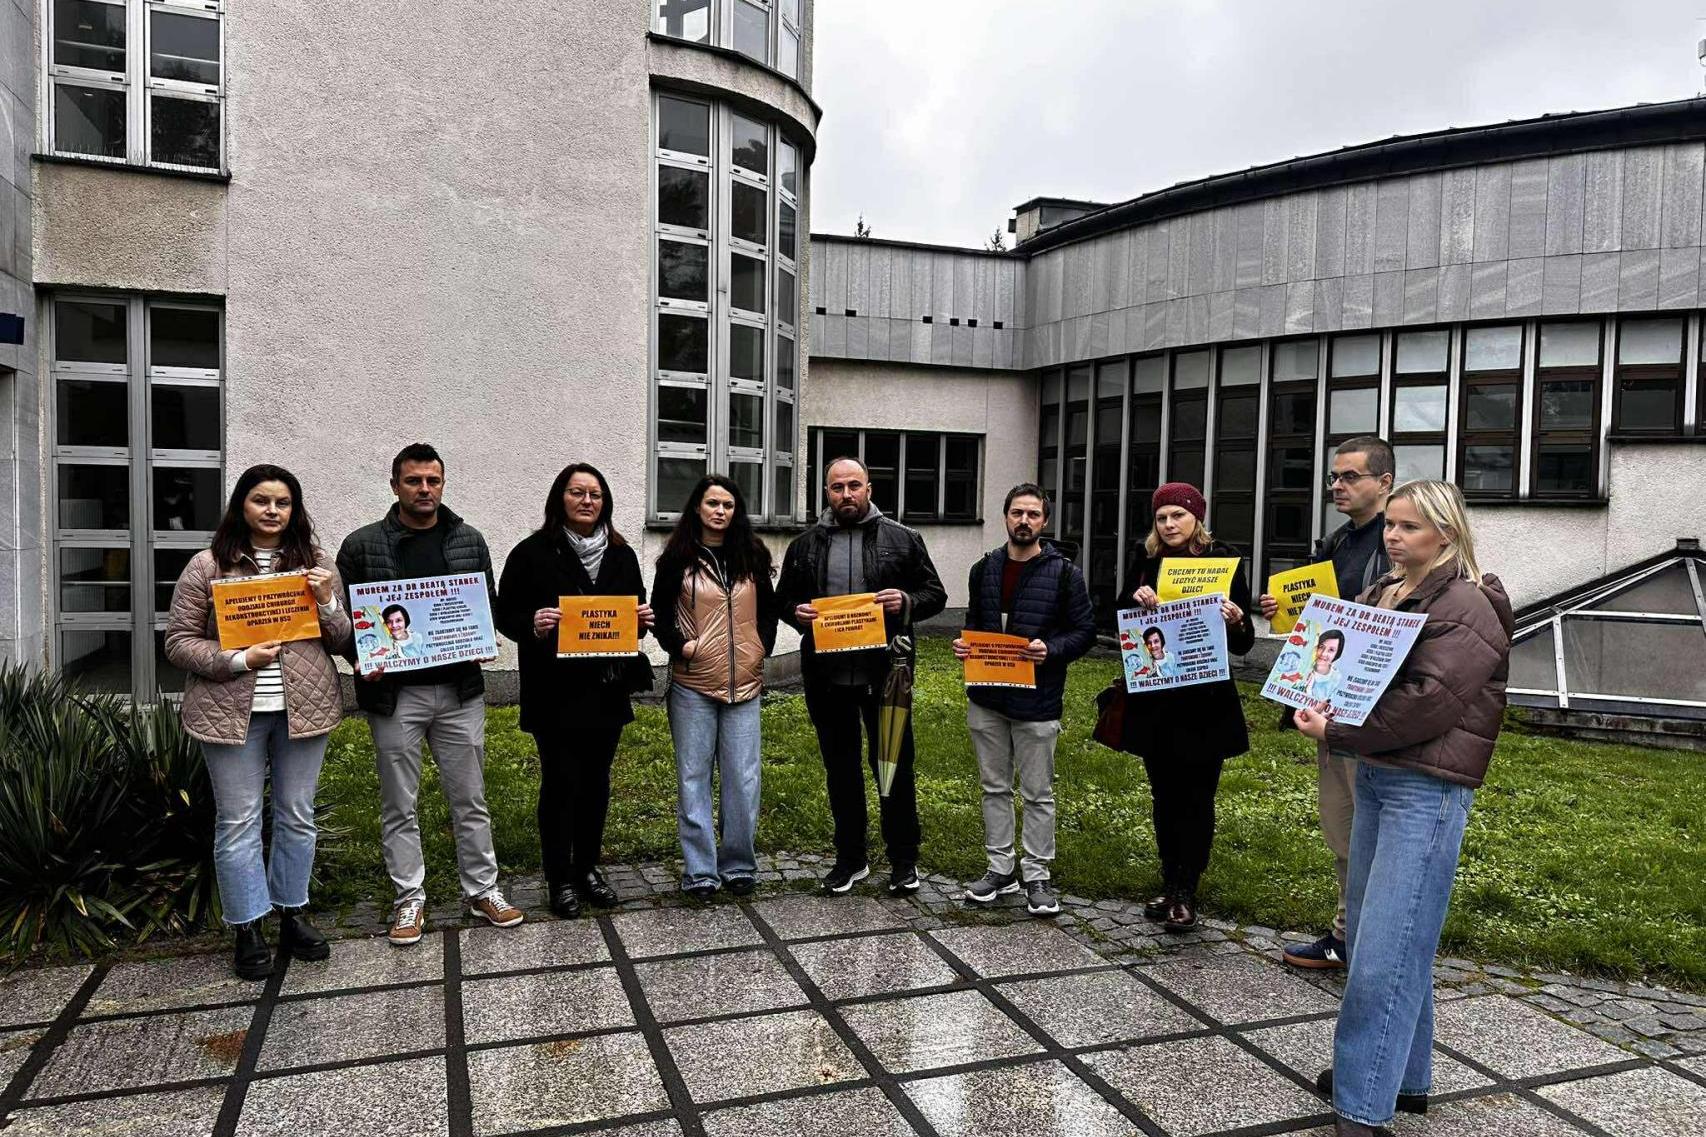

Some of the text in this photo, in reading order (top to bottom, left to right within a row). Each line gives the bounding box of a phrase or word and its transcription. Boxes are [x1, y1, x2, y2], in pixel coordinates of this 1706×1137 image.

[357, 586, 389, 595] MUREM
[406, 583, 417, 591] DR
[420, 580, 446, 589] BEATĄ
[449, 577, 479, 586] STANEK
[1283, 579, 1316, 592] PLASTYKA
[386, 594, 401, 602] JEJ
[405, 589, 447, 600] ZESPOŁEM
[1123, 610, 1150, 619] MUREM
[1312, 600, 1344, 613] MUREM
[1345, 608, 1357, 617] ZA
[1358, 611, 1371, 620] DR
[1372, 614, 1396, 627] BEATĄ
[1333, 617, 1350, 627] JEJ
[1351, 621, 1391, 636] ZESPOŁEM
[579, 632, 590, 640] NIE
[375, 657, 420, 670] WALCZYMY
[431, 652, 456, 662] NASZE
[459, 648, 483, 657] DZIECI
[1266, 683, 1277, 693] !!!
